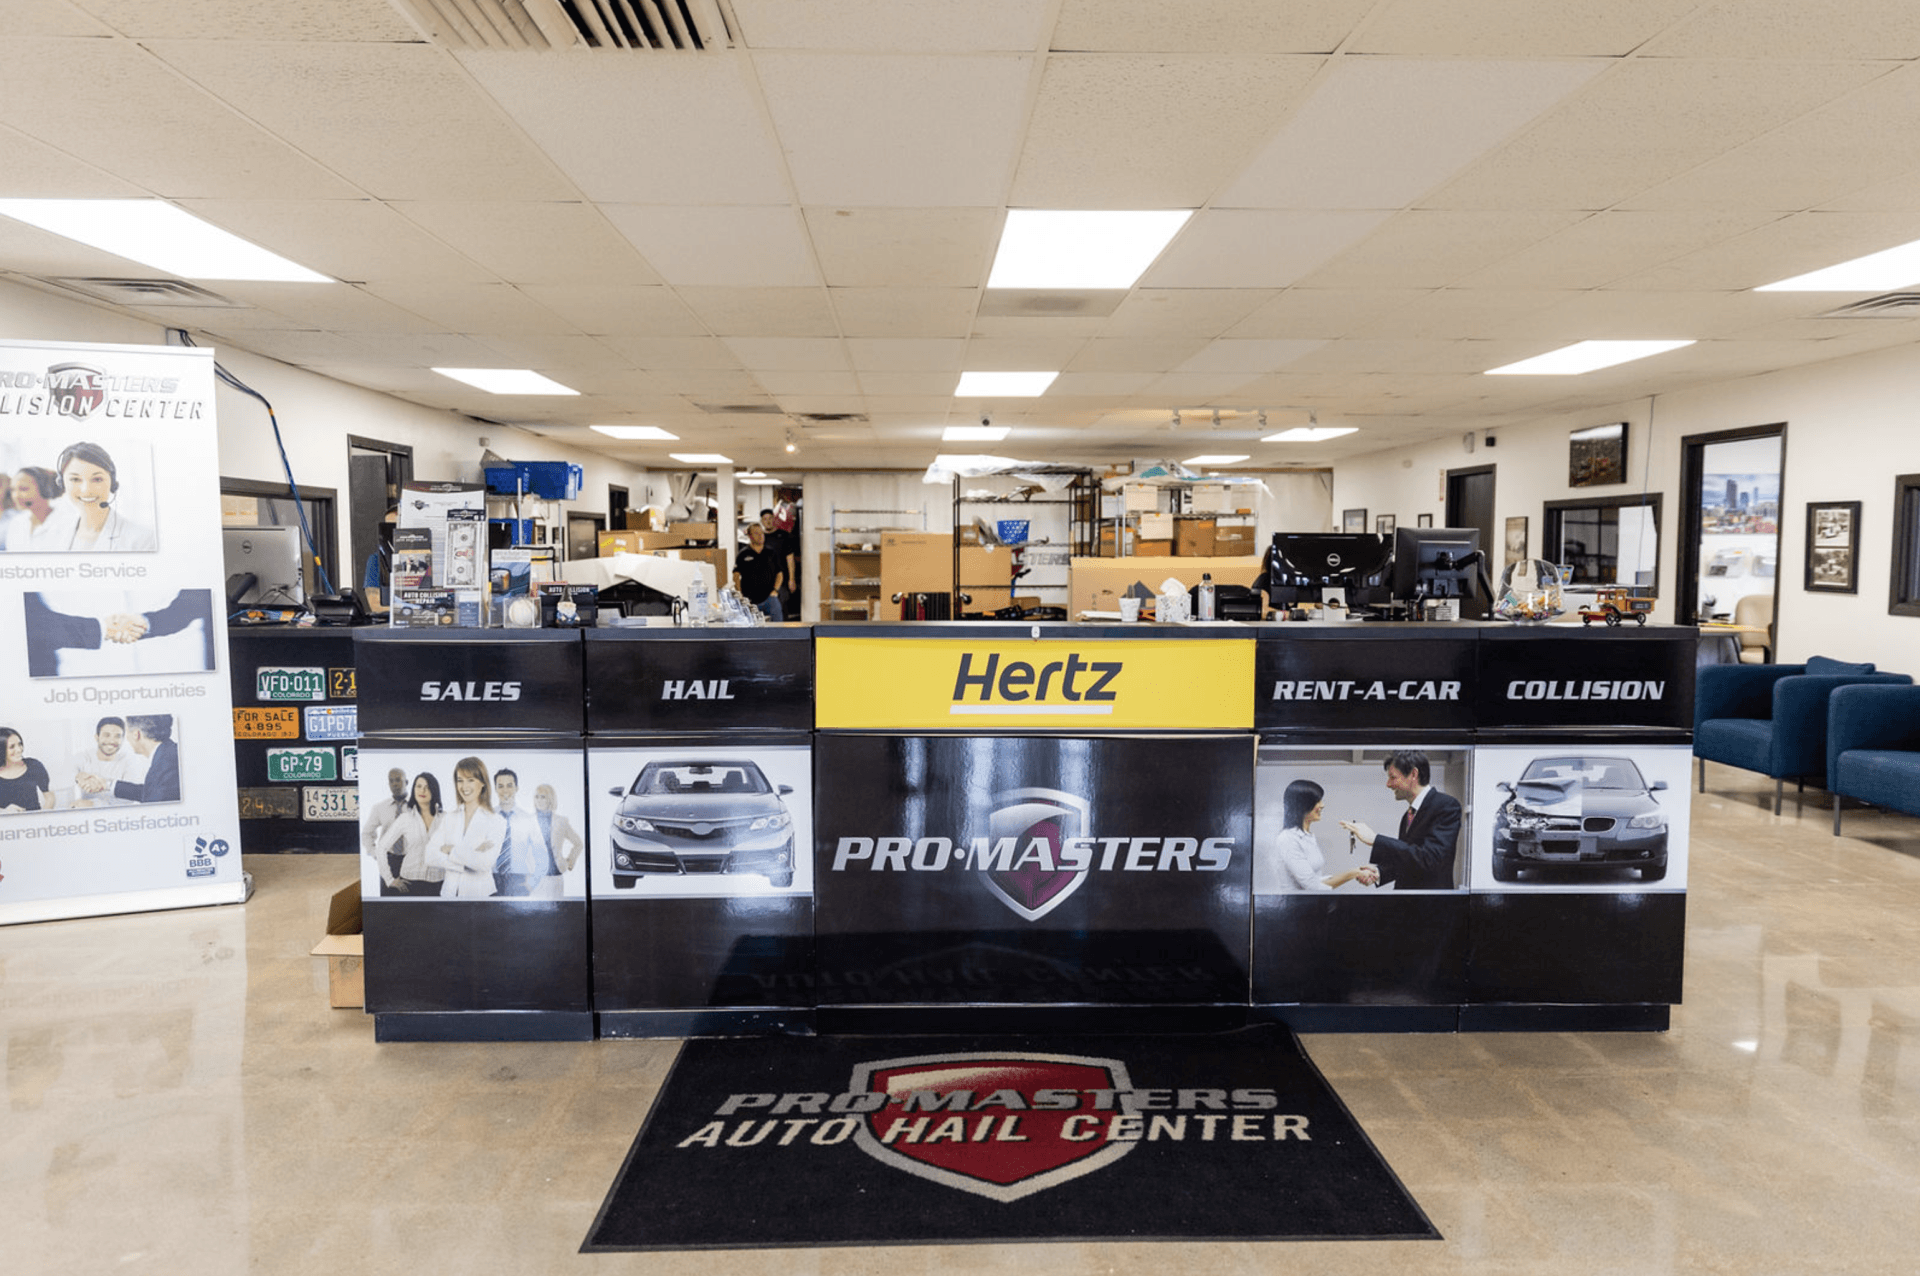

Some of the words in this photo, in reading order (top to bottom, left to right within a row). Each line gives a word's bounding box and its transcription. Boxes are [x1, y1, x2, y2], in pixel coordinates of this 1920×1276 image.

[105, 398, 203, 420] CENTER
[0, 564, 75, 579] stomer
[79, 562, 148, 578] Service
[952, 652, 1123, 701] Hertz
[43, 687, 79, 704] Job
[82, 682, 207, 705] Opportunities
[420, 681, 522, 701] SALES
[661, 679, 735, 700] HAIL
[1272, 680, 1461, 700] RENT-A-CAR
[1506, 680, 1665, 700] COLLISION
[237, 712, 259, 722] FOR
[264, 712, 295, 722] SALE
[0, 820, 90, 842] aranteed
[94, 812, 201, 834] Satisfaction
[189, 858, 212, 868] BBB
[676, 1117, 857, 1148] AUTO
[881, 1114, 1027, 1144] HAIL
[1060, 1114, 1313, 1142] CENTER
